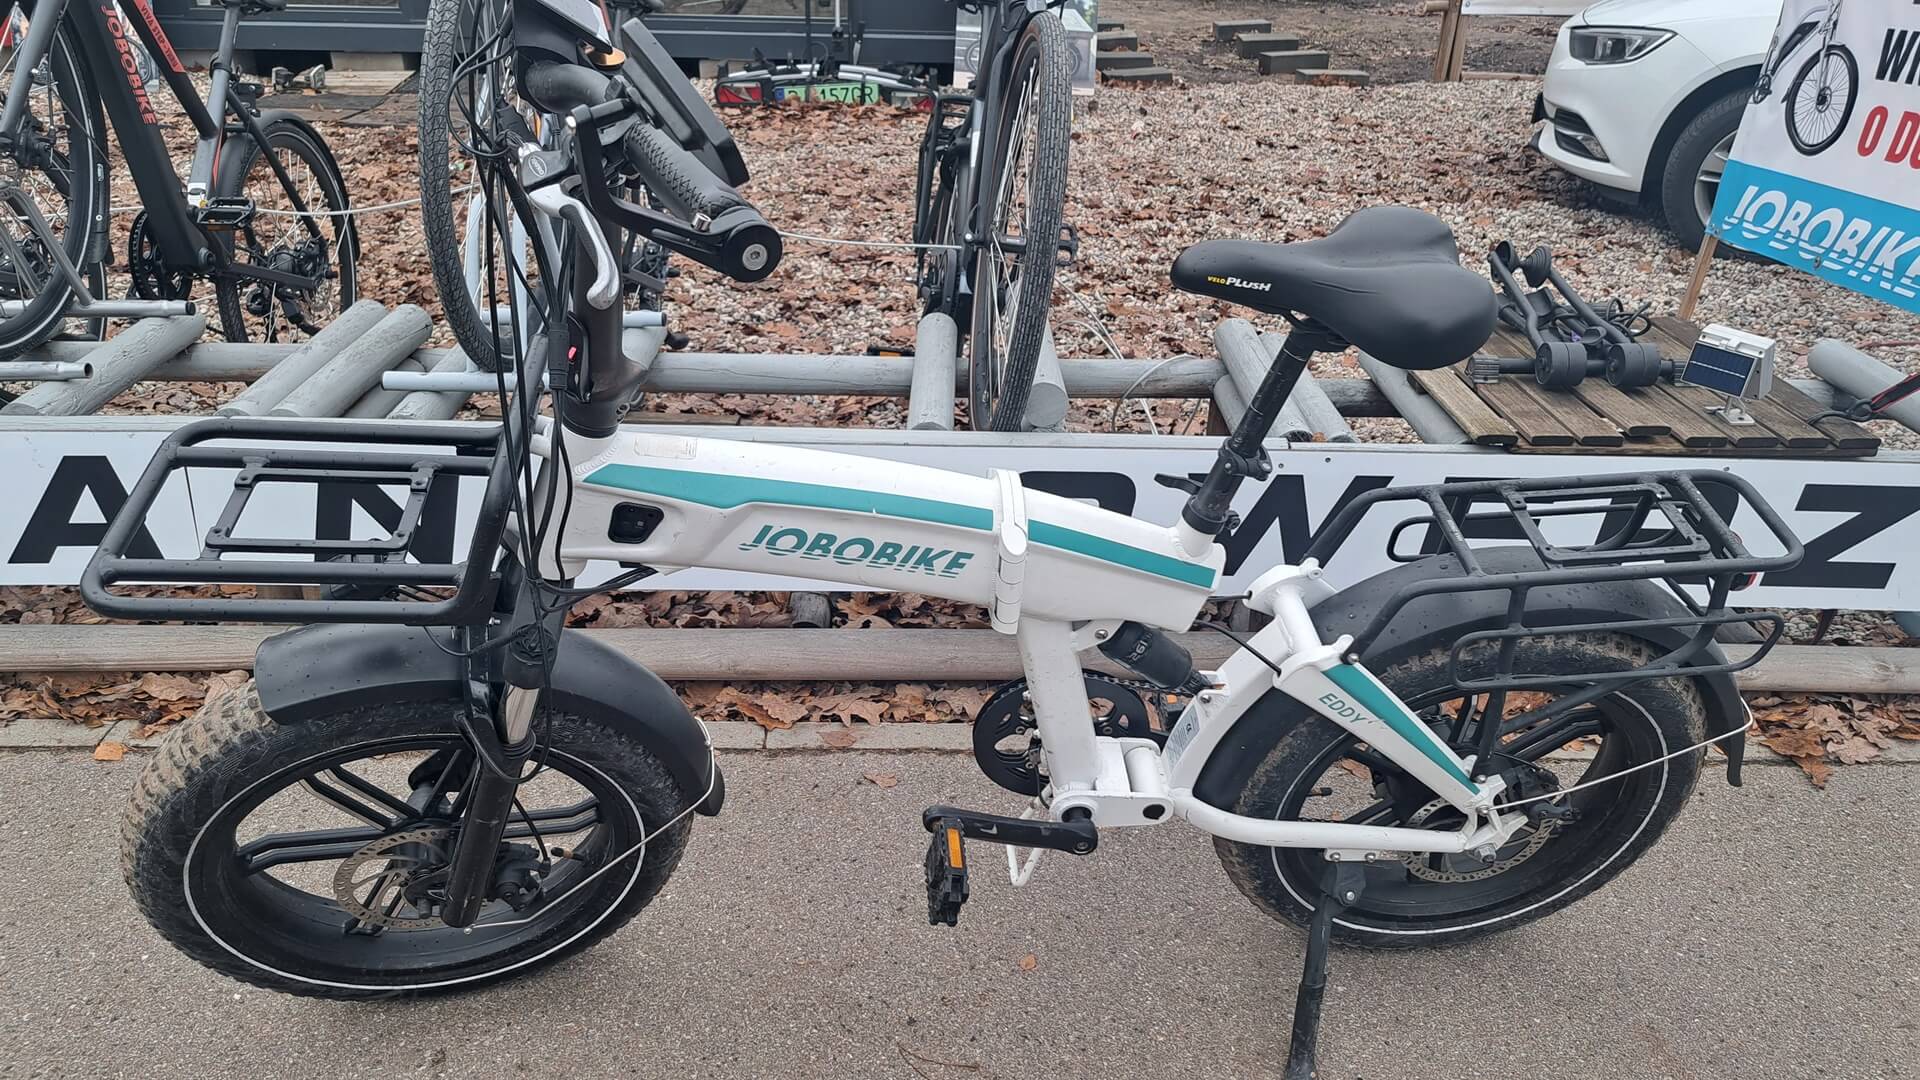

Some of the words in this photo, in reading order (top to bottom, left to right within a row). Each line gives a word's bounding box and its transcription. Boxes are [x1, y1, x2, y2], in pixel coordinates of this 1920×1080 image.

[141, 5, 154, 26] VIVA
[101, 4, 157, 124] JOBOBIKE
[1856, 105, 1888, 157] O
[1225, 276, 1272, 292] PLUSH
[738, 525, 974, 578] JOBOBIKE
[1318, 692, 1367, 723] EDDY
